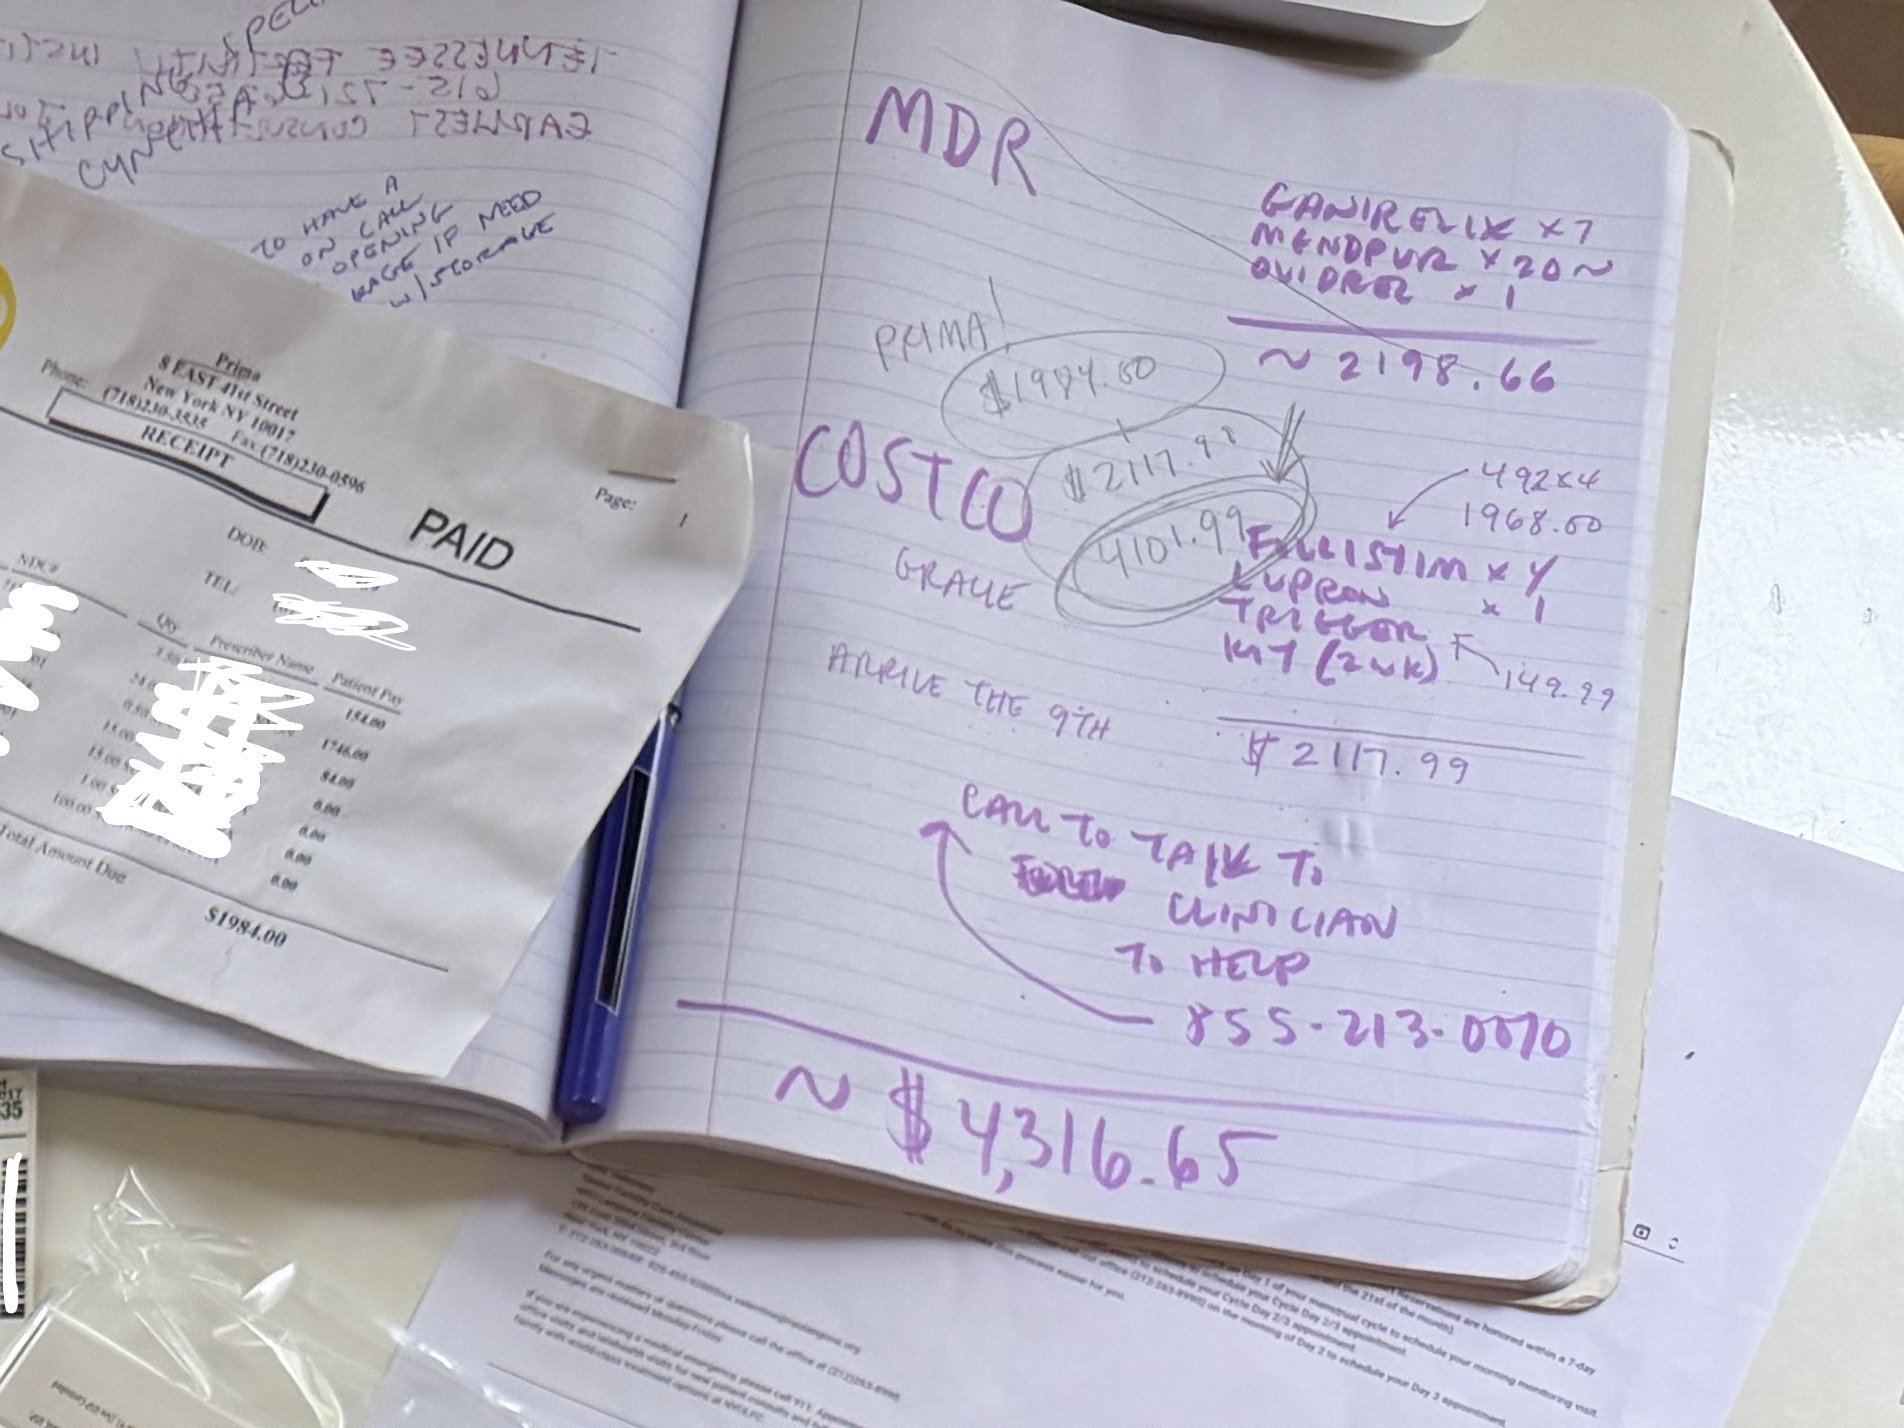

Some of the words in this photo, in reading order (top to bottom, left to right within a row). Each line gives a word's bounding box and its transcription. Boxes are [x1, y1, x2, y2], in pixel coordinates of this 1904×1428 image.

[866, 84, 1036, 196] MDR
[140, 425, 234, 473] RECEIPT
[793, 419, 1034, 545] COSTCO
[409, 508, 515, 572] PAID
[1130, 828, 1259, 886] TALK
[1192, 948, 1310, 984] HELP
